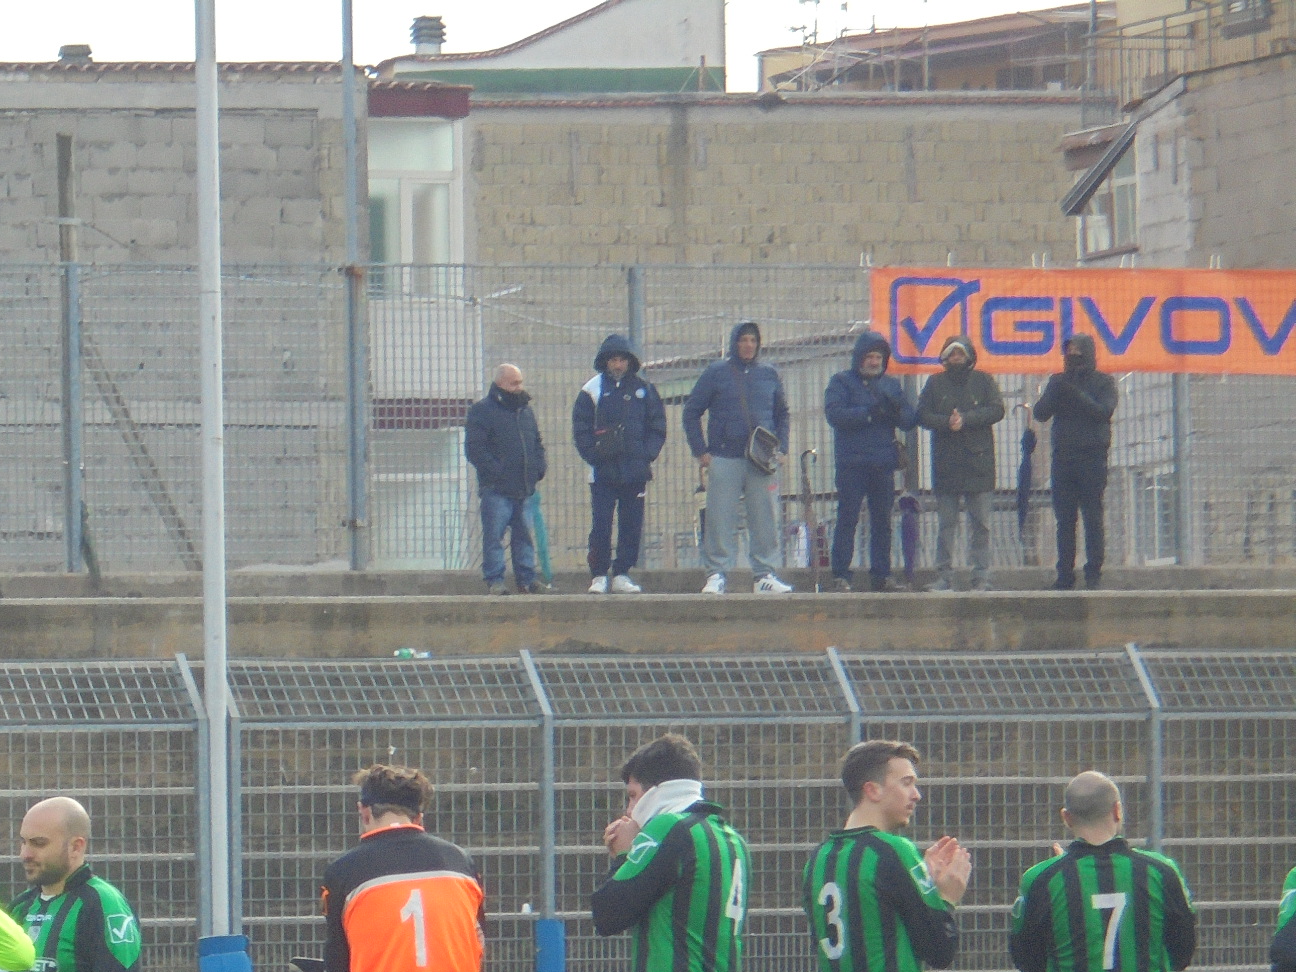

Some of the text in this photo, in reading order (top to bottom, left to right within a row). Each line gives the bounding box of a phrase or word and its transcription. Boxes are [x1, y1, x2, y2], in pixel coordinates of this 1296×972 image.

[400, 888, 427, 967] 1
[725, 858, 745, 936] 4
[817, 882, 846, 960] 3
[1091, 892, 1126, 970] 7
